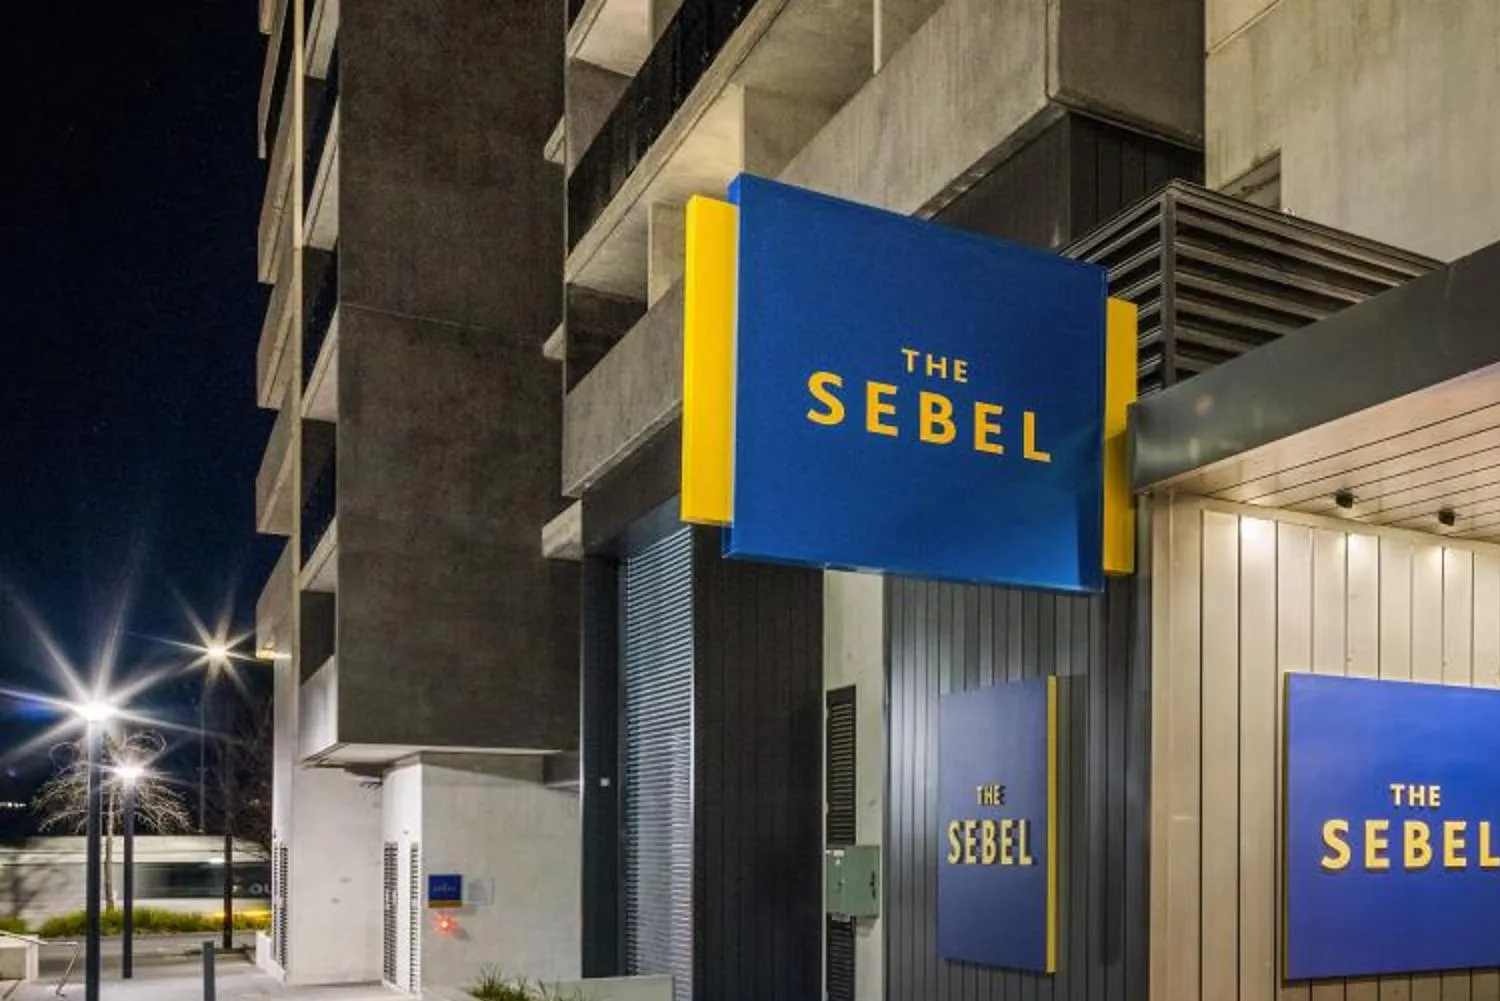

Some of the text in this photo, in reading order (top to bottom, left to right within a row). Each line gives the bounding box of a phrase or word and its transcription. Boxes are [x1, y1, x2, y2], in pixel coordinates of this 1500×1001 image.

[901, 348, 968, 383] THE
[807, 371, 1052, 463] SEBEL
[976, 784, 1004, 805] THE
[1389, 784, 1441, 807] THE
[947, 819, 1033, 865] SEBEL
